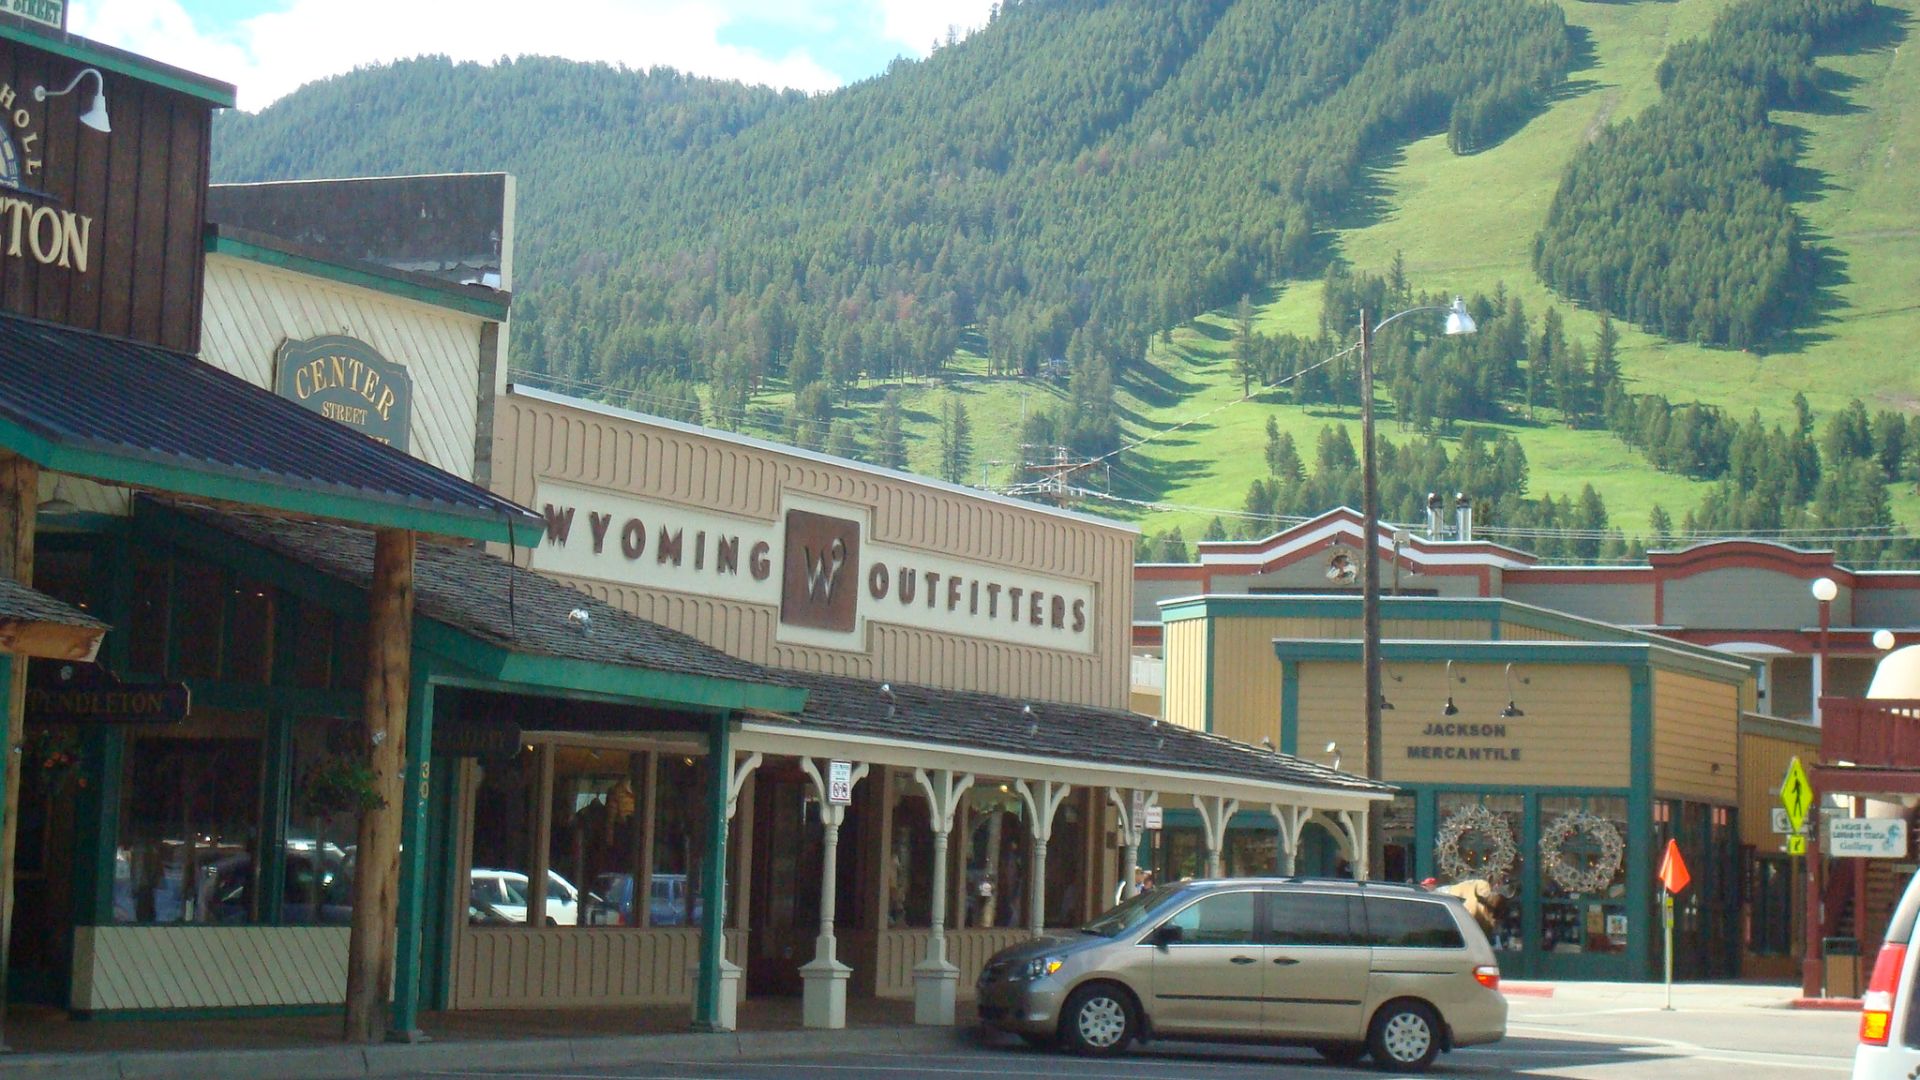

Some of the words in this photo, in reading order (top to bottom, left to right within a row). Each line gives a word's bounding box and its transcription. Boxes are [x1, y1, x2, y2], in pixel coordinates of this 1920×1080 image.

[0, 197, 92, 272] TON
[295, 356, 395, 421] CENTER
[322, 401, 368, 426] STREET
[544, 503, 771, 581] WYOMING
[869, 562, 1085, 633] OUTFITTERS
[1407, 745, 1521, 761] MERCANTILE
[1422, 723, 1506, 738] JACKSON
